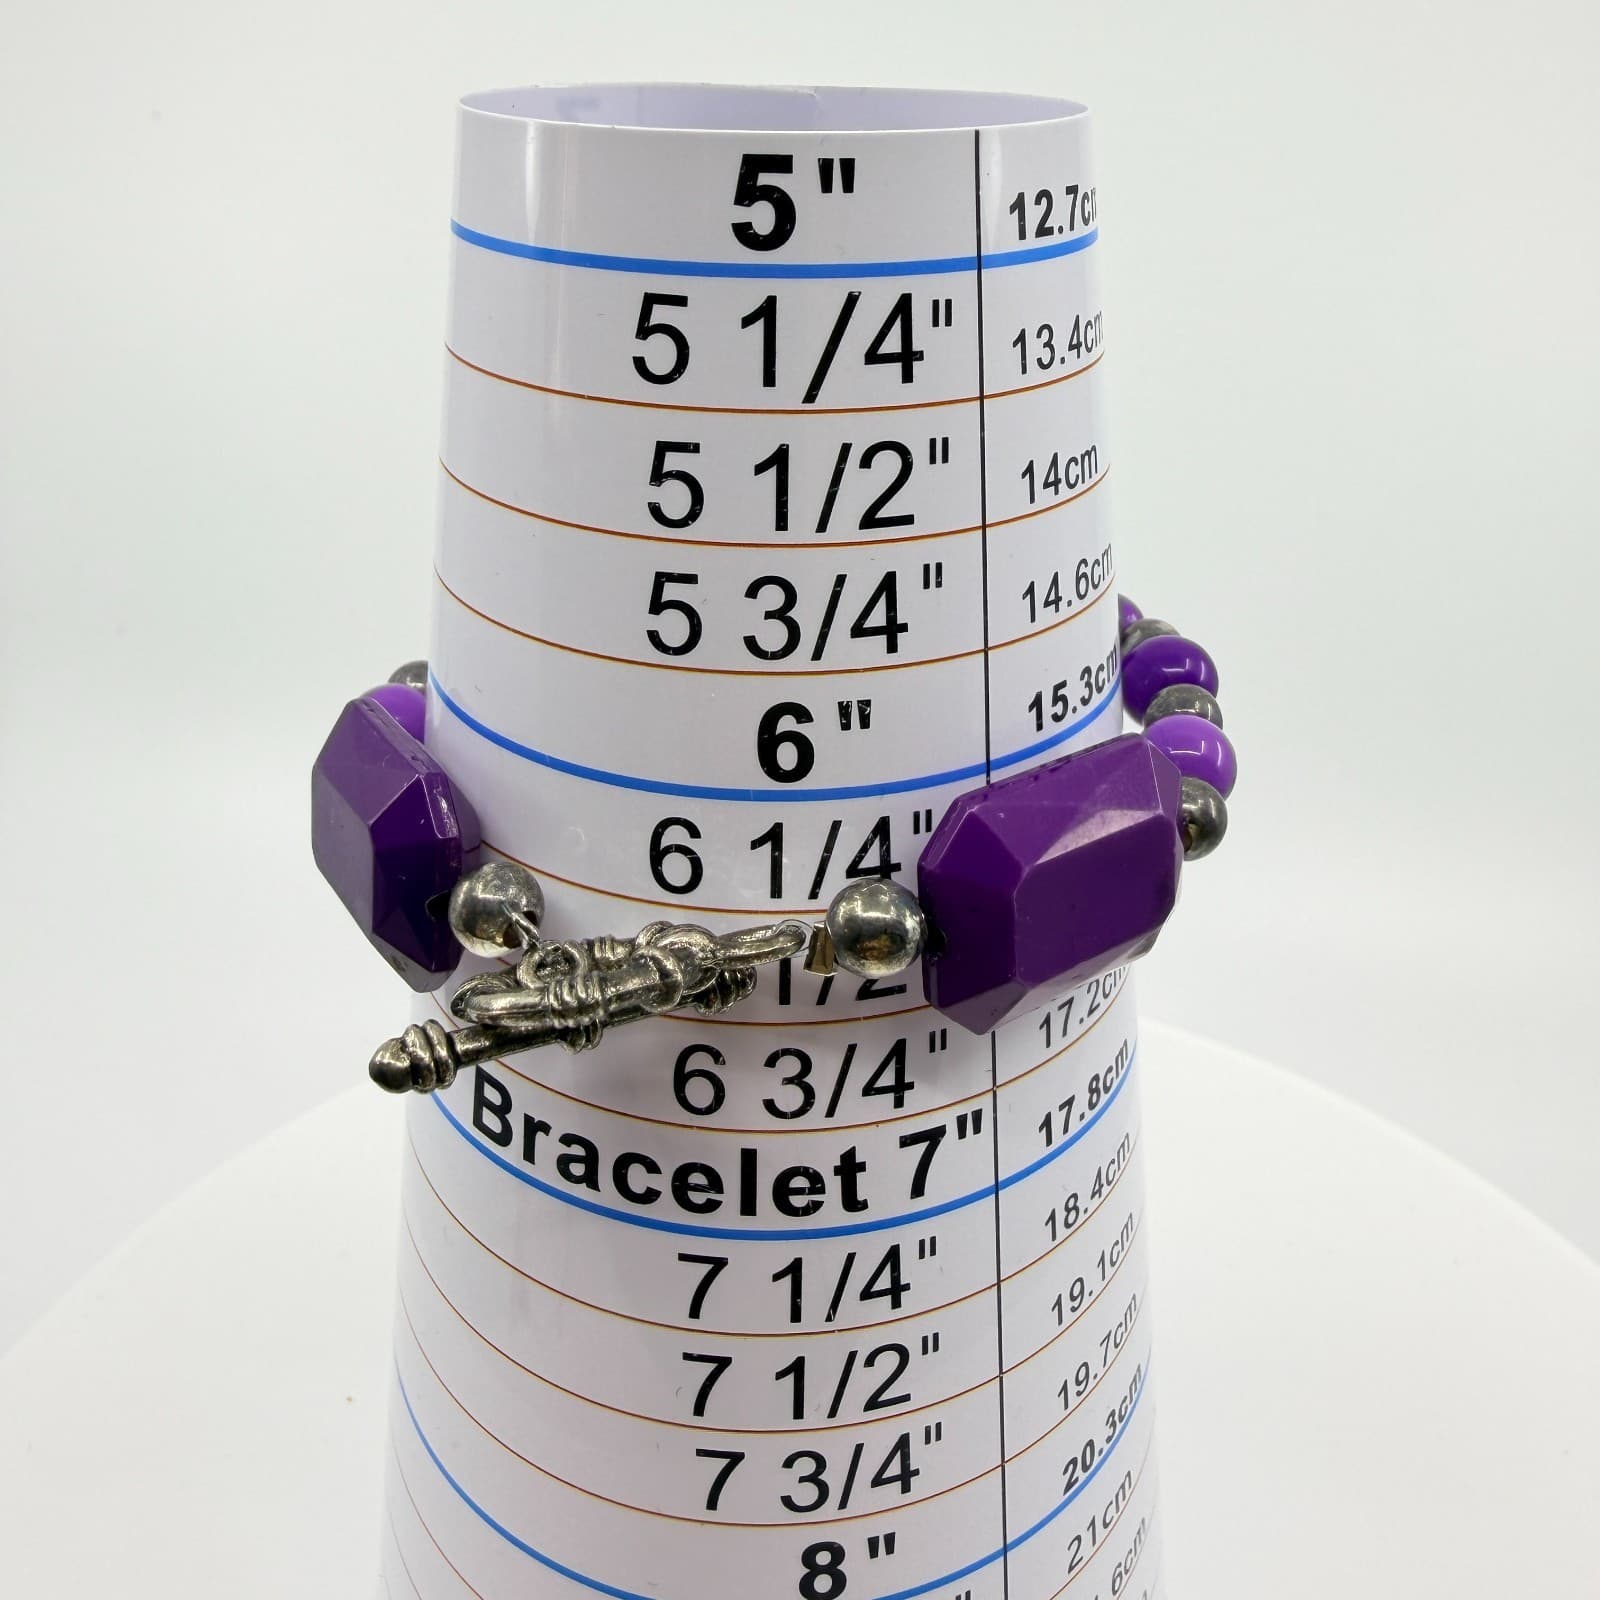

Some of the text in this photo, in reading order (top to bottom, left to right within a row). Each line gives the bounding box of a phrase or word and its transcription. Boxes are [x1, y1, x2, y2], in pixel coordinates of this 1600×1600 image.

[731, 153, 856, 251] 5"
[631, 290, 953, 405] 5 1/4"
[1012, 311, 1104, 375] 13.4cm
[647, 436, 950, 534] 5 1/2"
[1021, 444, 1099, 505] 14cm
[646, 561, 943, 662] 5 3/4"
[1022, 543, 1113, 624] 14.6cm
[1028, 645, 1118, 732] 15.3cm
[756, 698, 872, 784] 6"
[649, 808, 933, 900] 6 1/4"
[673, 1028, 948, 1120] 6 3/4"
[1038, 1038, 1129, 1148] 17.8cm
[472, 1064, 983, 1218] Bracelet 7"
[1044, 1132, 1131, 1242] 18.4cm
[677, 1235, 937, 1324] 7 1/4"
[1051, 1212, 1134, 1326] 19.1cm
[682, 1331, 940, 1421] 7 1/2"
[1057, 1293, 1137, 1411] 19.7cm
[695, 1421, 942, 1514] 7 3/4"
[1062, 1363, 1142, 1496] 20.3cm
[798, 1531, 896, 1600] 8"
[1067, 1470, 1132, 1574] 21cm
